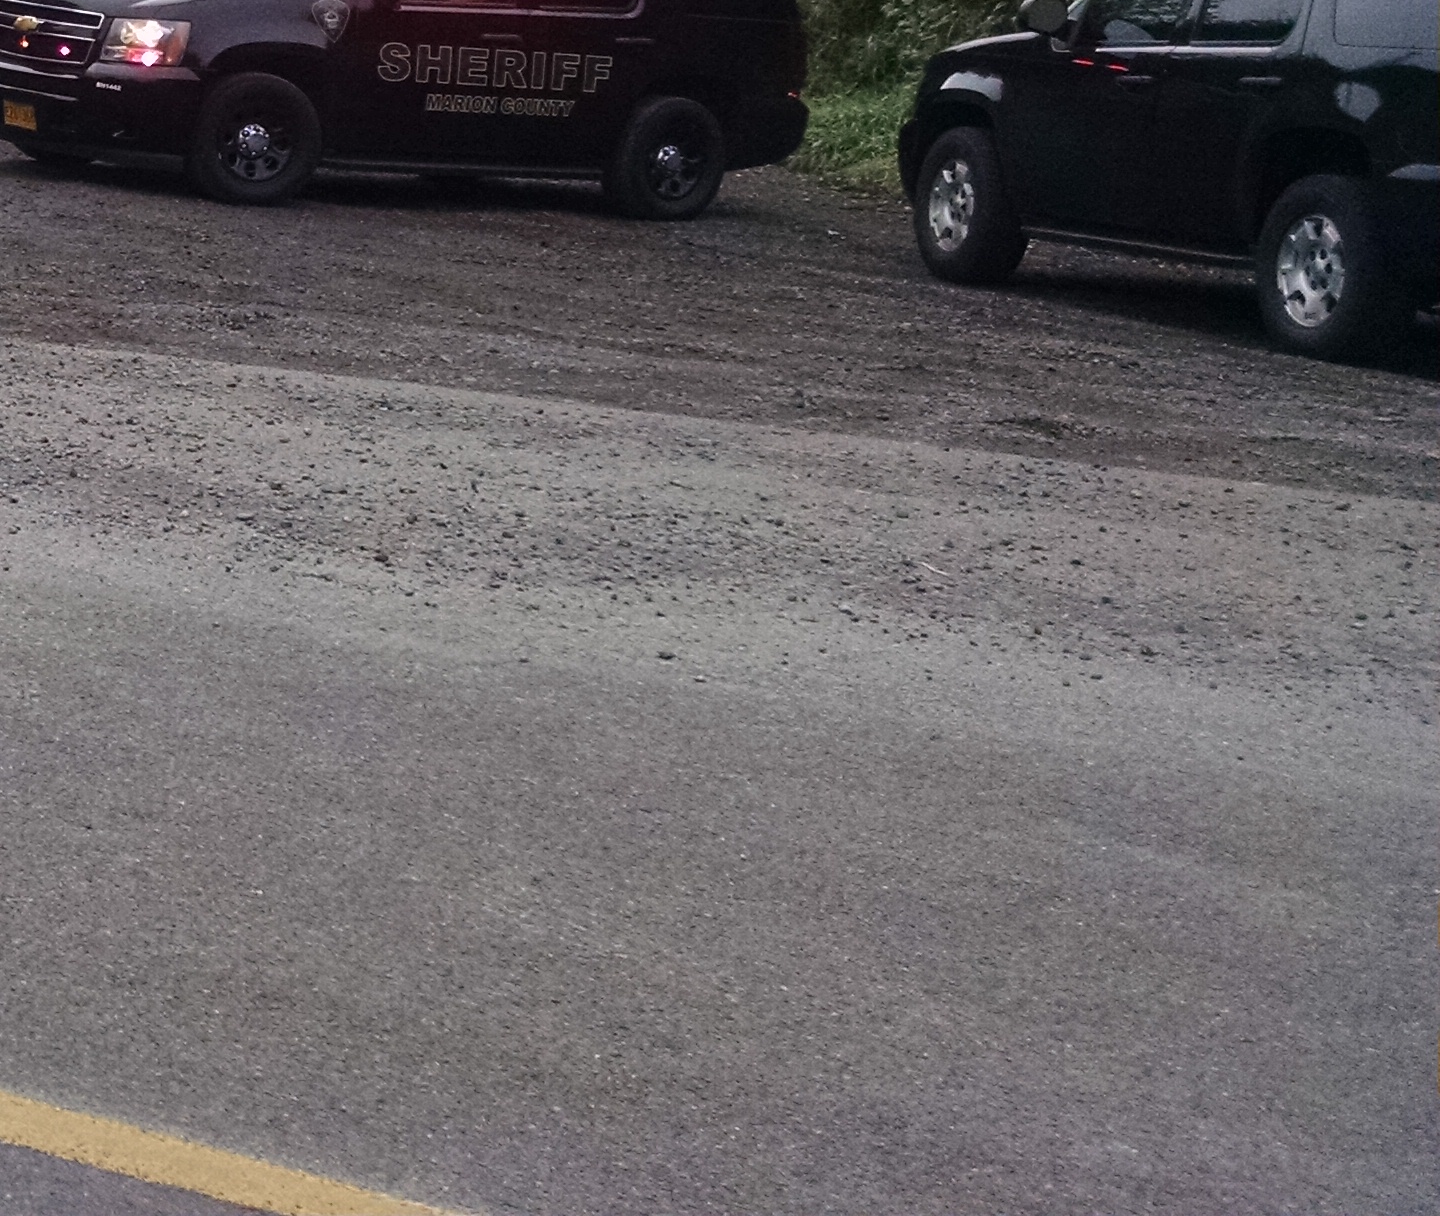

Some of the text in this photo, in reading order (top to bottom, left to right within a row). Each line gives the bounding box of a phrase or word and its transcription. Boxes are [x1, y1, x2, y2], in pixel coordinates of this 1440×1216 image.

[377, 41, 613, 93] SHERIFF
[425, 93, 575, 117] MARION COUNTY
